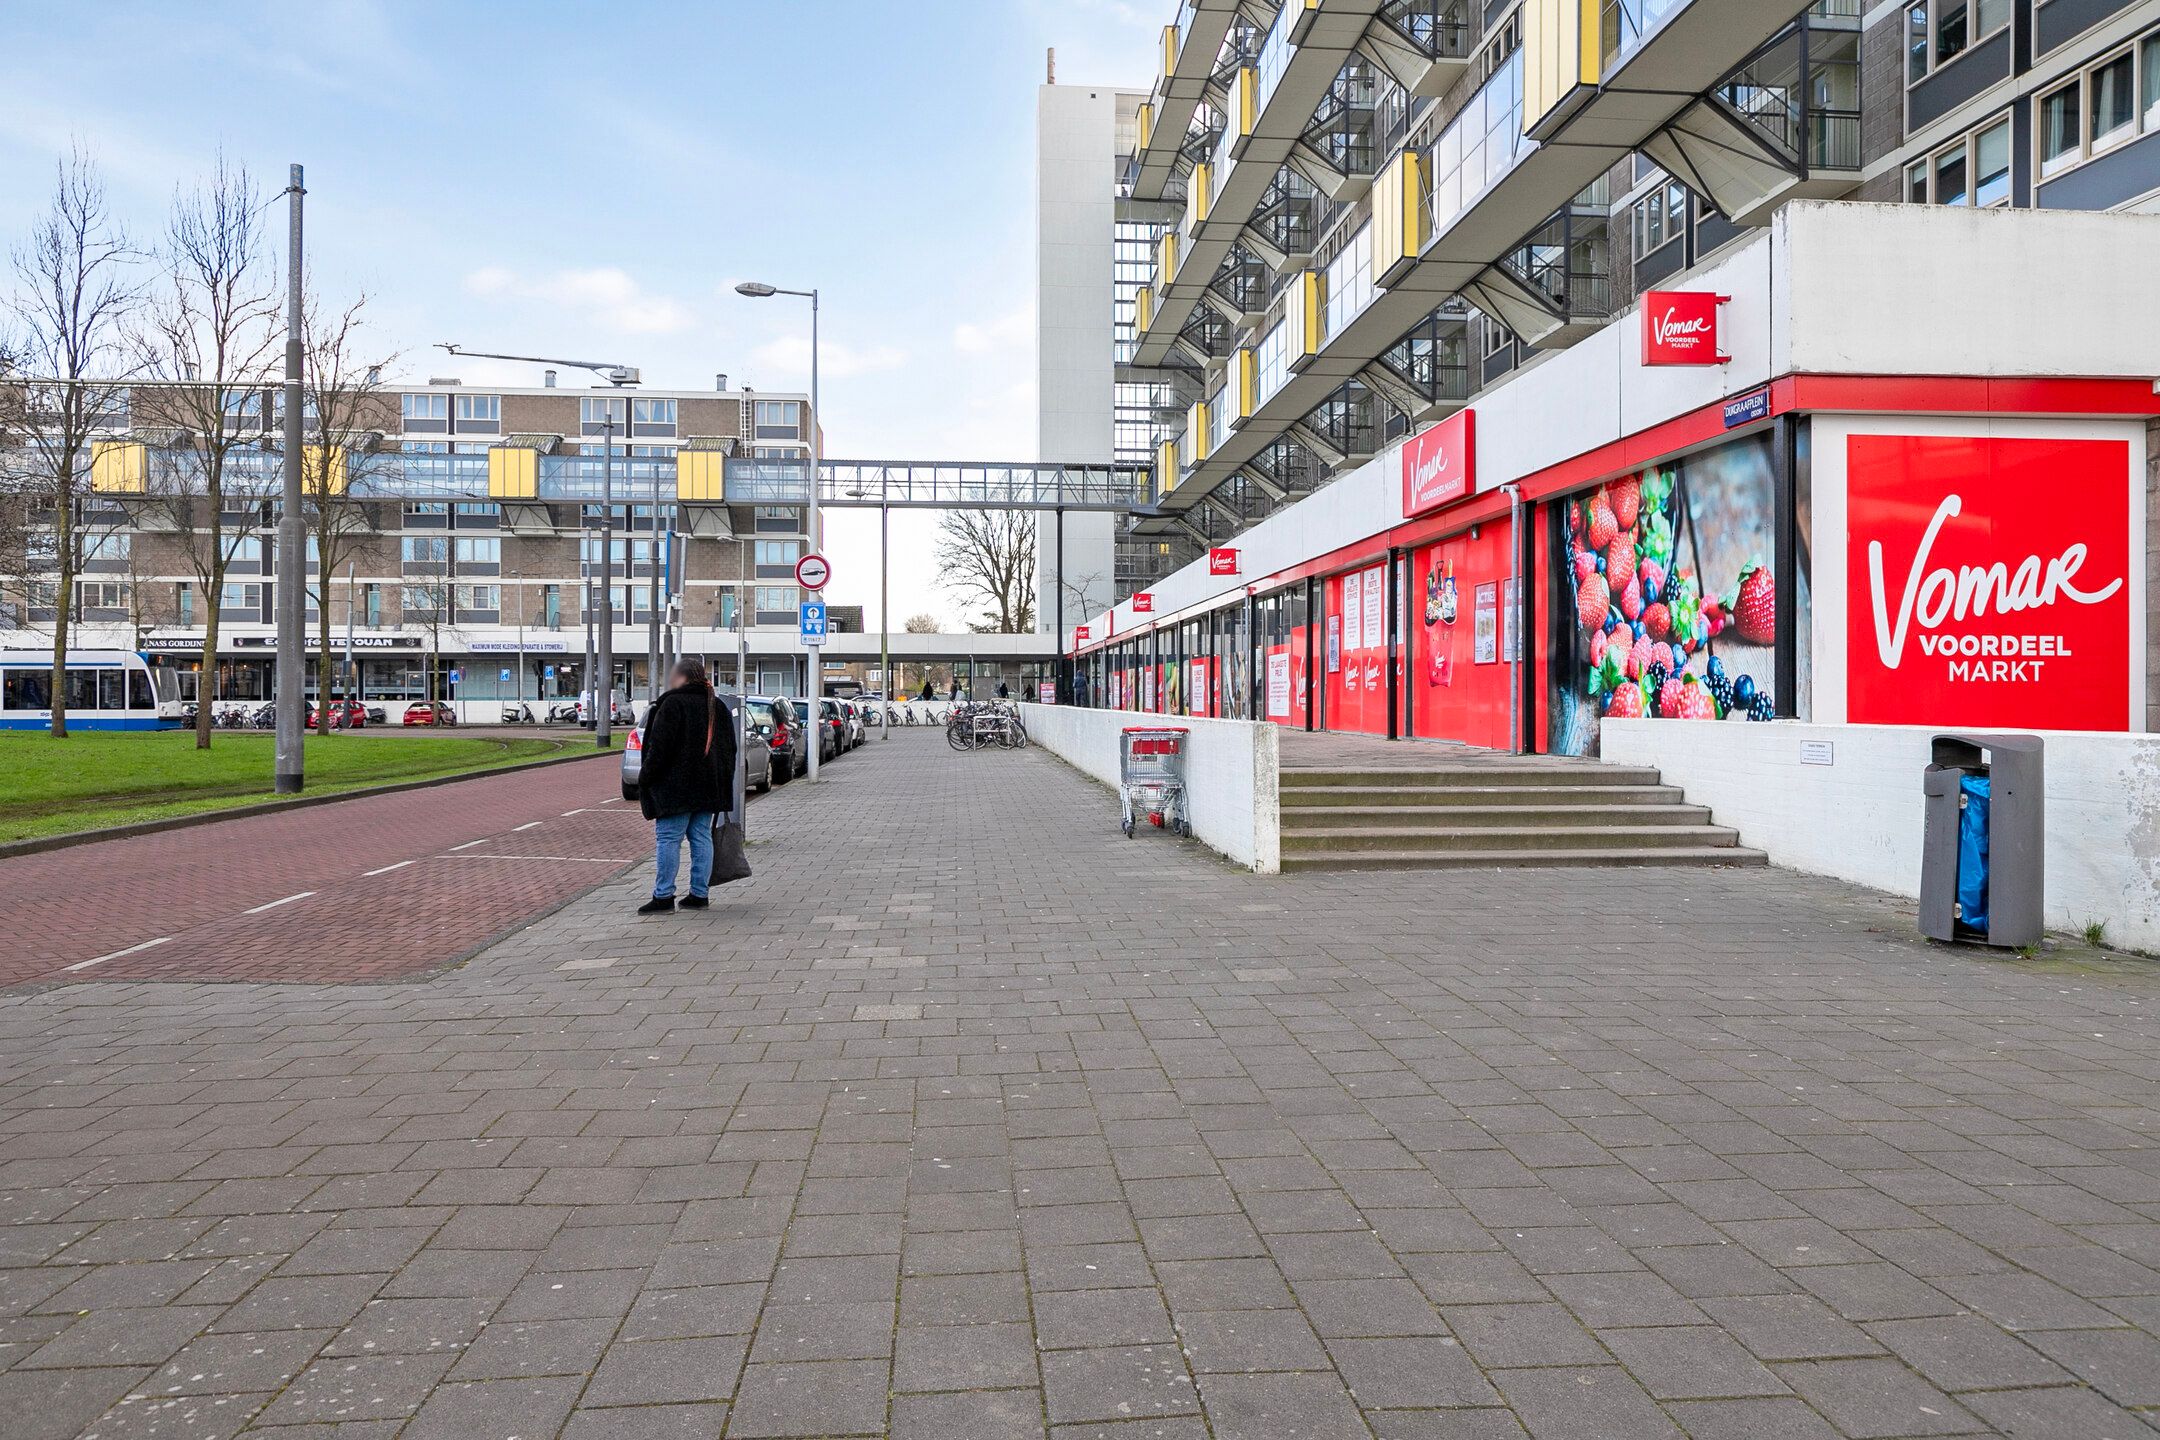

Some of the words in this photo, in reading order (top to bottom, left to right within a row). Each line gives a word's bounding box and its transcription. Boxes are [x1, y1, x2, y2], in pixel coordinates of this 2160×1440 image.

[1653, 306, 1712, 346] Vomar
[1410, 438, 1448, 510] Vomar
[1868, 494, 2123, 670] Vomar
[1918, 635, 2072, 656] VOORDEEL
[1948, 660, 2045, 682] MARKT
